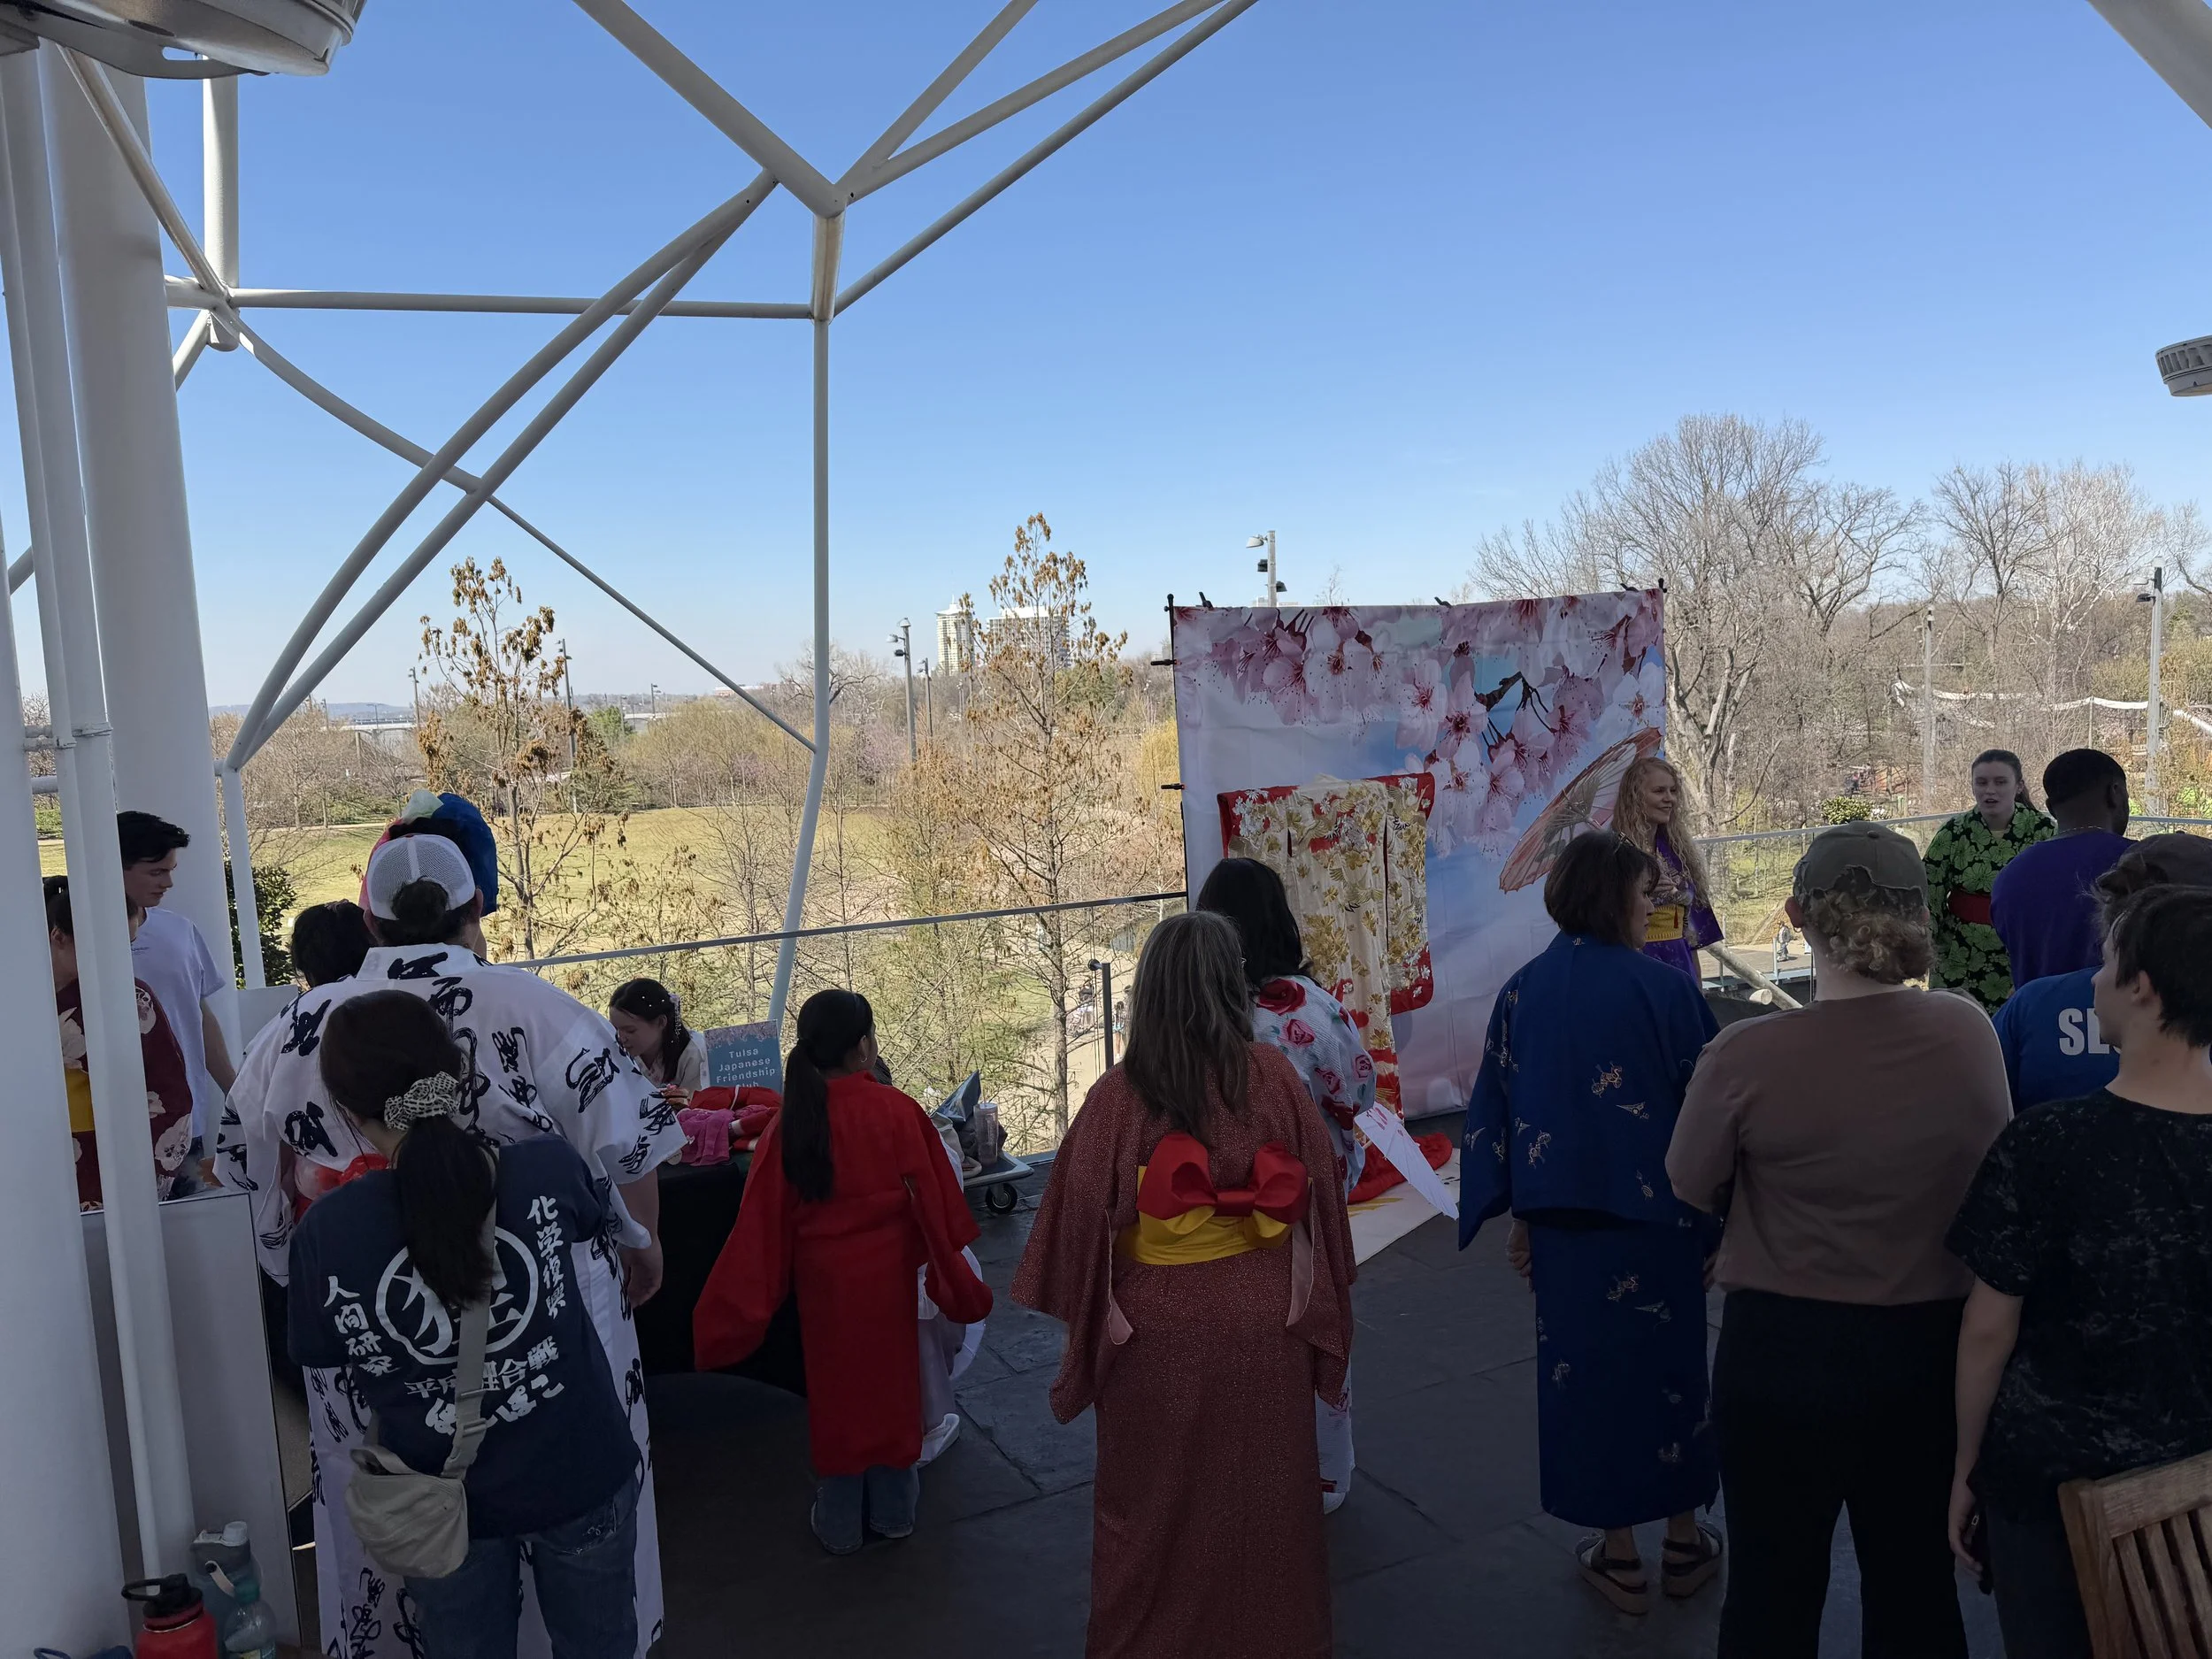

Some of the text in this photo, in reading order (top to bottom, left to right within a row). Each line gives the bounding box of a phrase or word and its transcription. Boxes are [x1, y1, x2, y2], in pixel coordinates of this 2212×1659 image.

[729, 1048, 759, 1059] Tulsa
[718, 1057, 772, 1072] Japanese
[716, 1067, 776, 1084] Friendship
